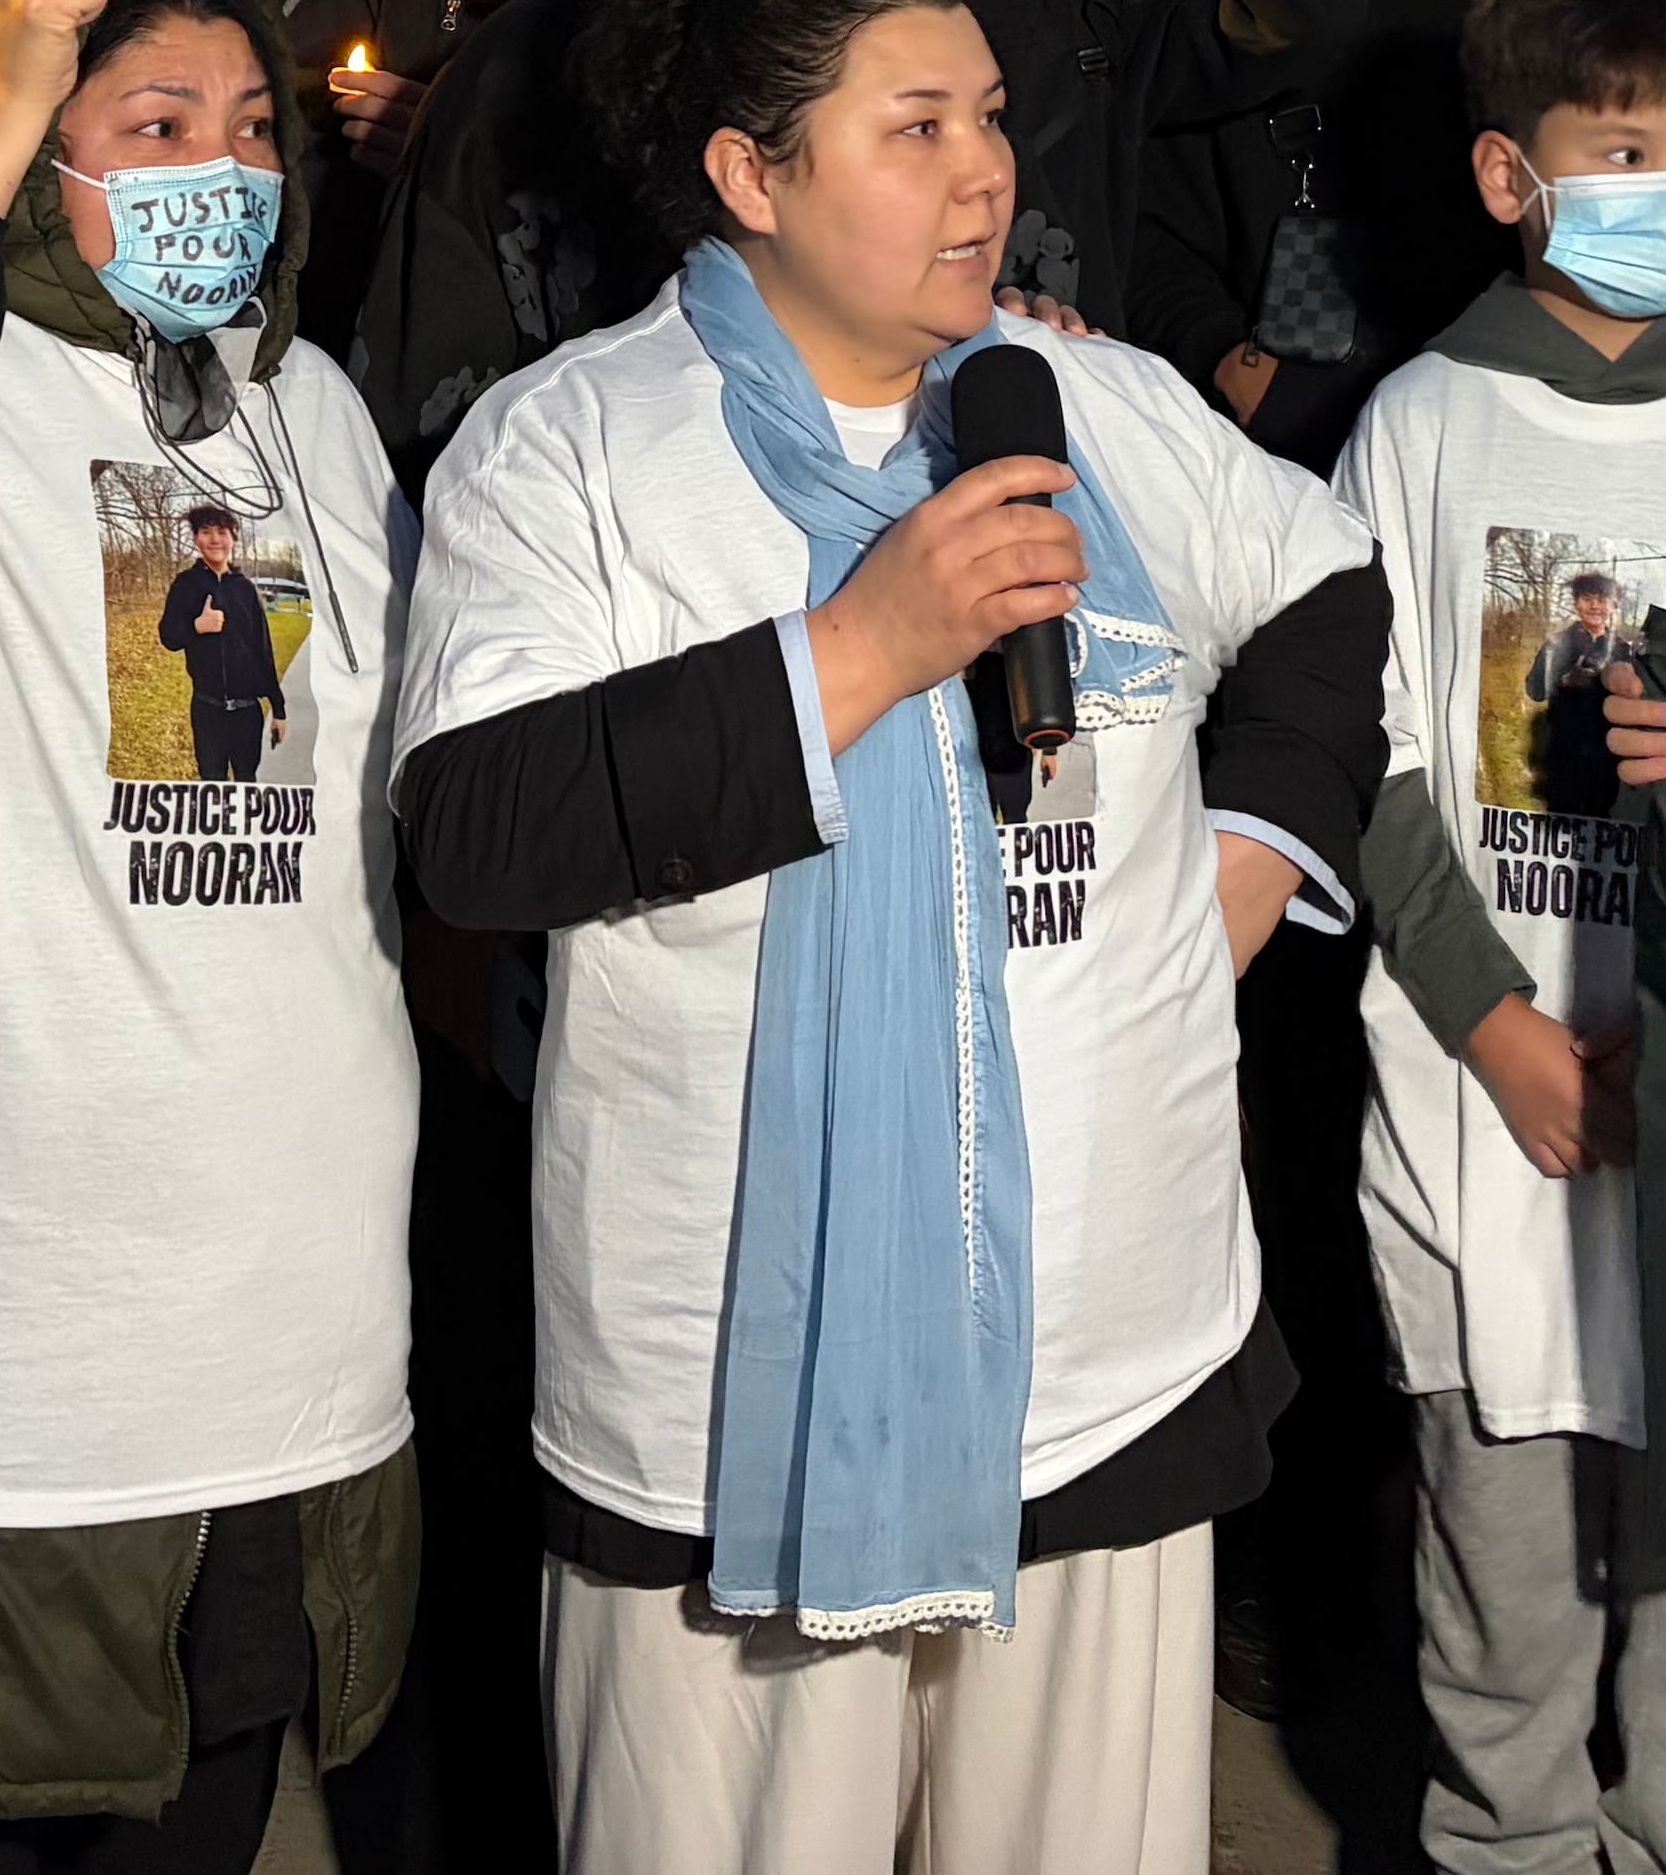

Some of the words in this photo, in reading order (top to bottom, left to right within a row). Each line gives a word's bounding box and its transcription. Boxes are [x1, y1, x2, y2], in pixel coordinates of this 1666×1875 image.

[153, 232, 252, 263] POUR
[154, 265, 258, 306] NOORAN
[102, 781, 237, 837] JUSTICE
[243, 785, 317, 837] POUR
[1478, 806, 1588, 863] JUSTICE
[1593, 822, 1640, 868] PO
[128, 840, 304, 907] NOORAN
[1014, 820, 1097, 878] POUR
[1004, 878, 1086, 950] RAN
[1496, 857, 1631, 927] NOORA
